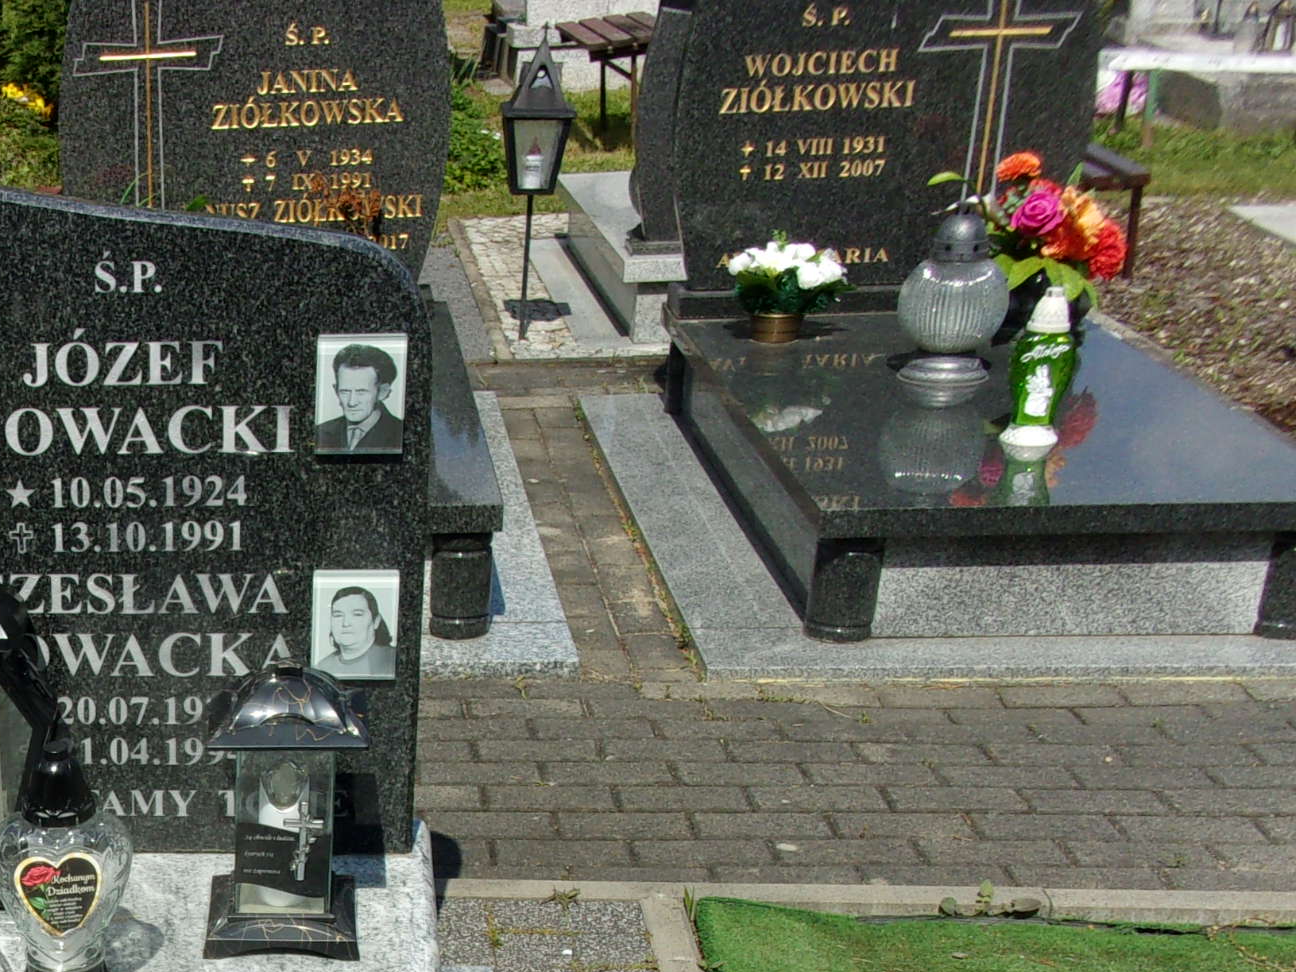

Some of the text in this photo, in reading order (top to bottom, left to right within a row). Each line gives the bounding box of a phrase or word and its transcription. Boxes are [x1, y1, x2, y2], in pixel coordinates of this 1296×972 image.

[745, 48, 899, 78] WOJCIECH
[257, 69, 358, 96] JANINA
[719, 78, 917, 115] ZIÓŁKOWSKI
[211, 97, 404, 130] ZIÓŁKOWSKA
[265, 149, 373, 168] 6 V 1934
[765, 136, 886, 157] 14 VIII 1931
[265, 174, 276, 191] 7
[330, 172, 372, 189] 1991
[764, 160, 885, 181] 12 XII 2007
[274, 193, 423, 223] ZIÓŁKSKI
[816, 248, 889, 265] ARIA
[95, 251, 162, 293] Ś.P.
[23, 328, 223, 388] JÓZEF
[51, 475, 247, 509] 10.05.1924
[51, 520, 243, 553] 13.10.1991
[23, 632, 293, 677] WACKA
[57, 696, 211, 726] 20.07.19
